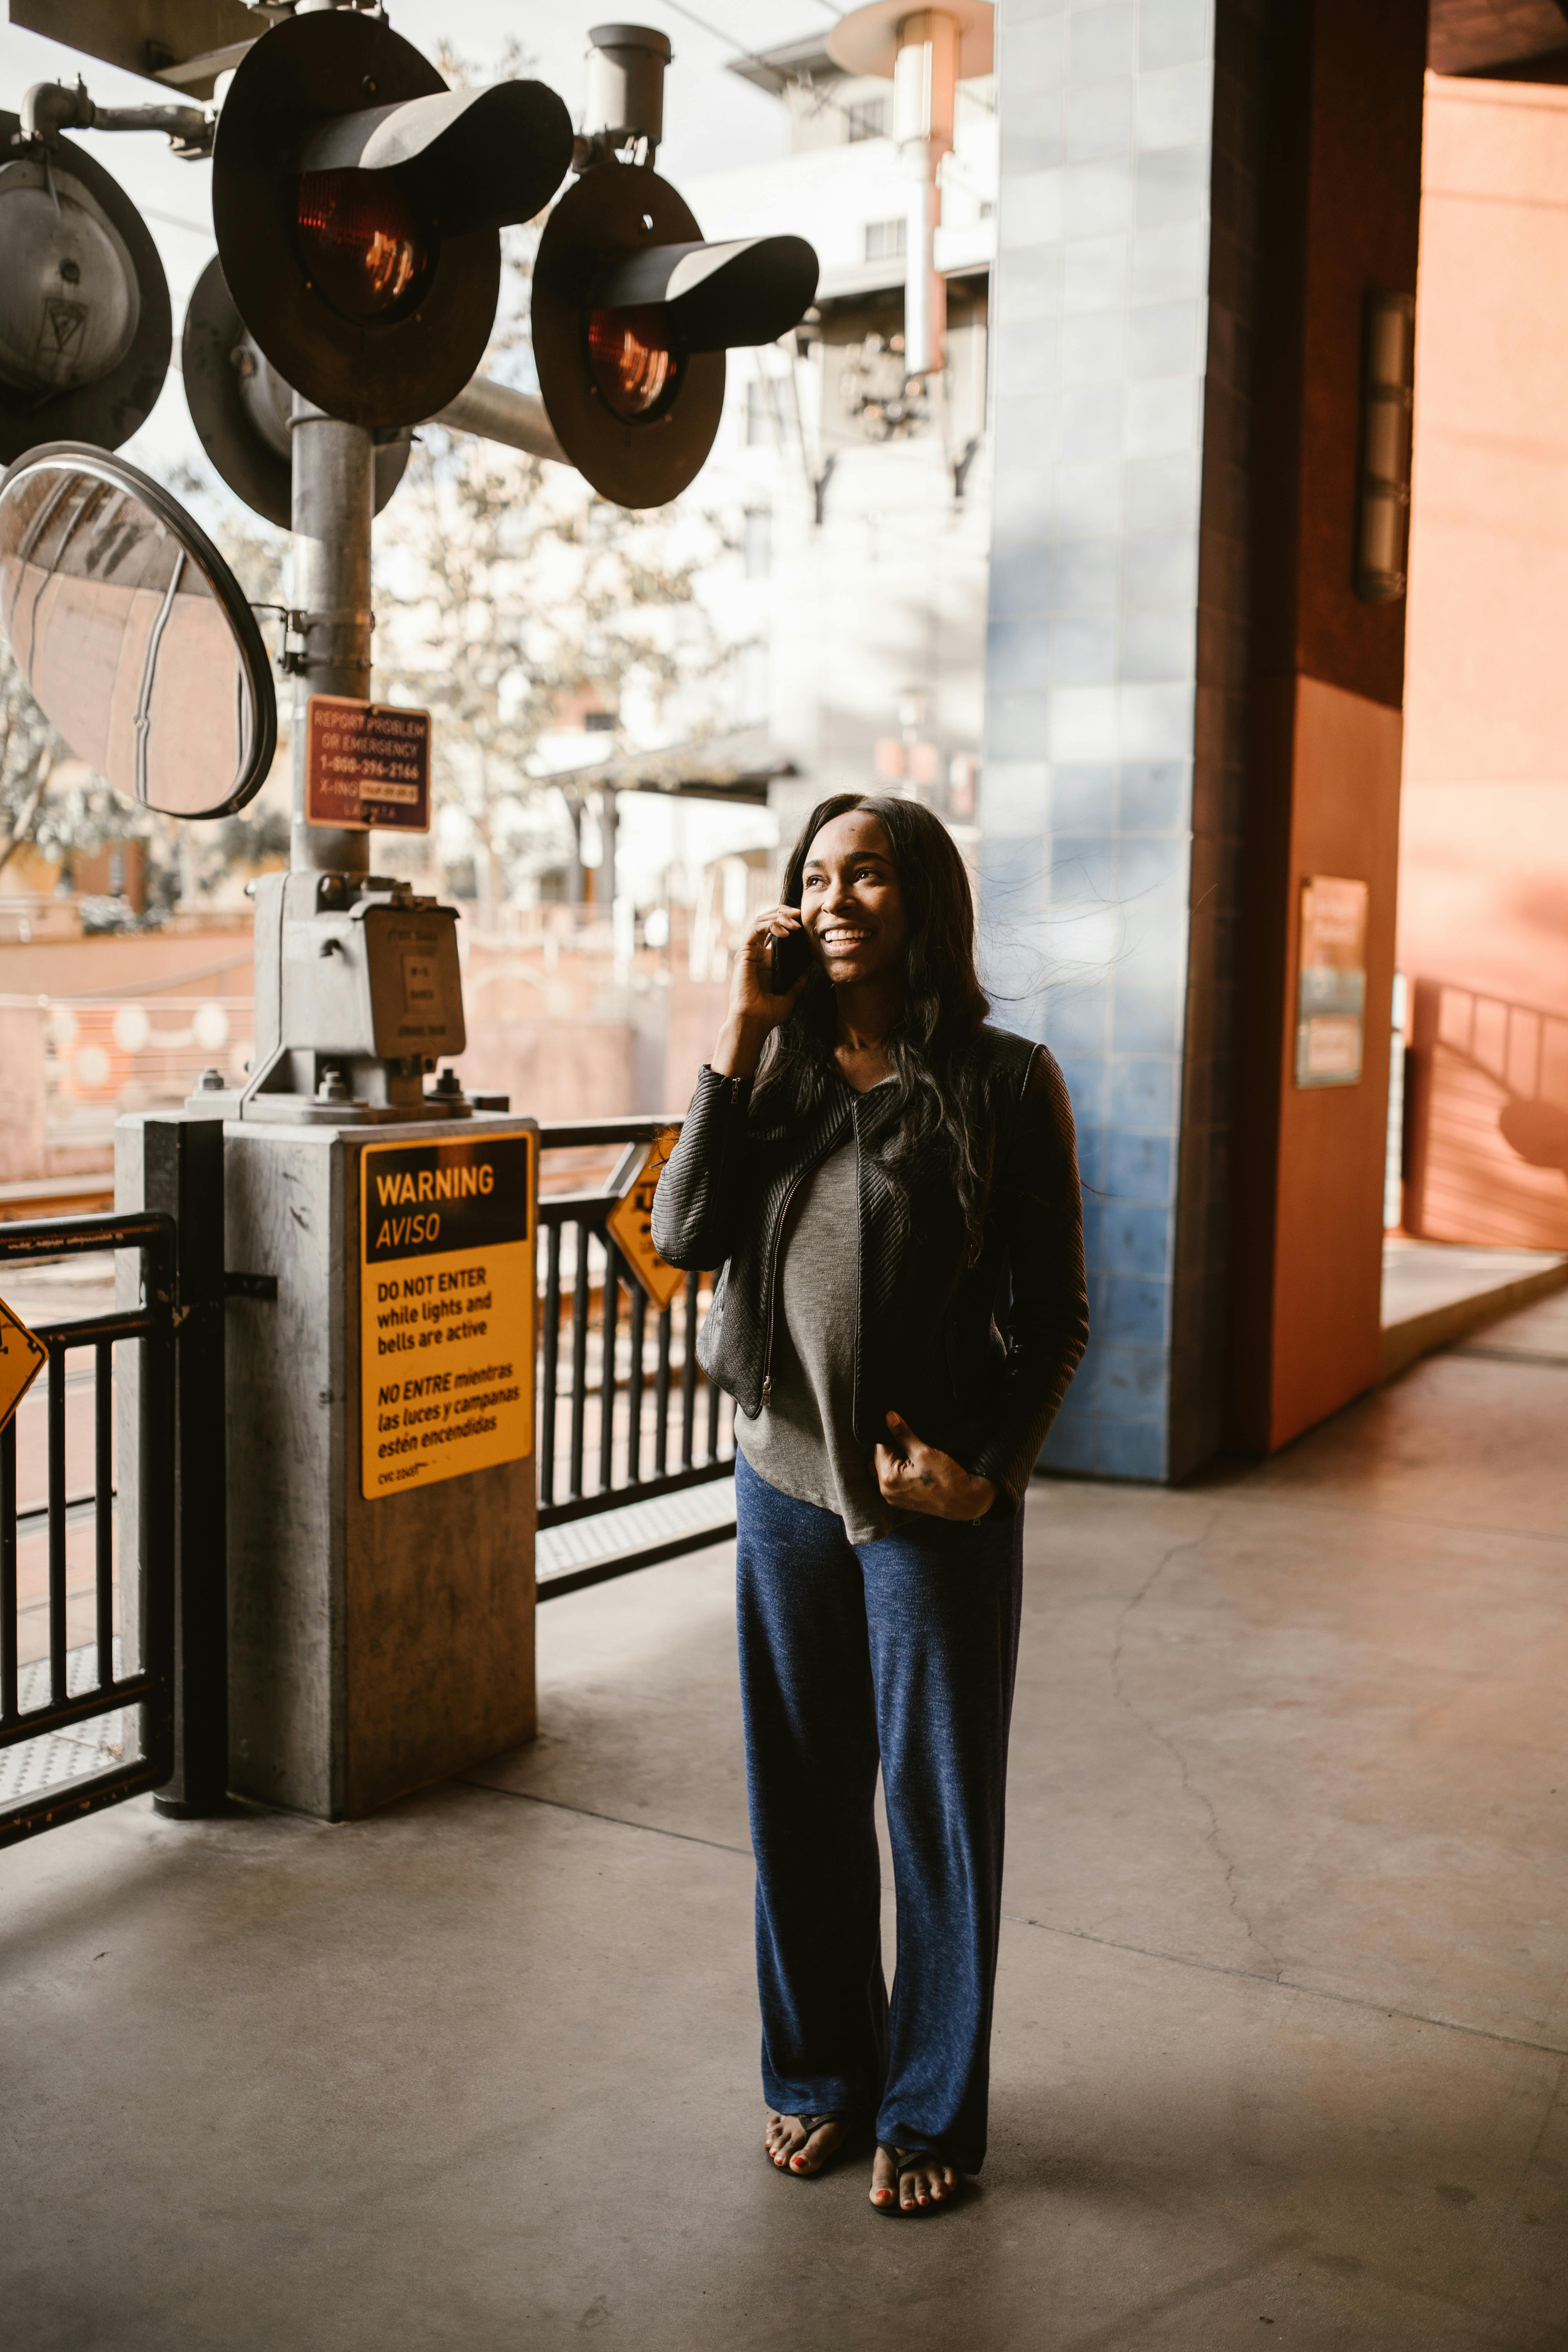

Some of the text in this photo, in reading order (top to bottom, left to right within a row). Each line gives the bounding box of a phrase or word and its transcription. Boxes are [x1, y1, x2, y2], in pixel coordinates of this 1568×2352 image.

[315, 711, 425, 737] REPORT PROBLEM
[322, 733, 417, 758] OR EMERGENCY
[319, 777, 357, 797] X-ING
[376, 1164, 494, 1207] WARNING
[375, 1213, 440, 1249] AVISO
[378, 1267, 486, 1302] DO NOT ENTER
[377, 1290, 492, 1328] while lights and
[378, 1319, 487, 1355] bells are active
[378, 1363, 513, 1406] NO ENTRE mientras
[378, 1386, 520, 1432] las luces y campanas
[378, 1416, 497, 1459] estén encendidas
